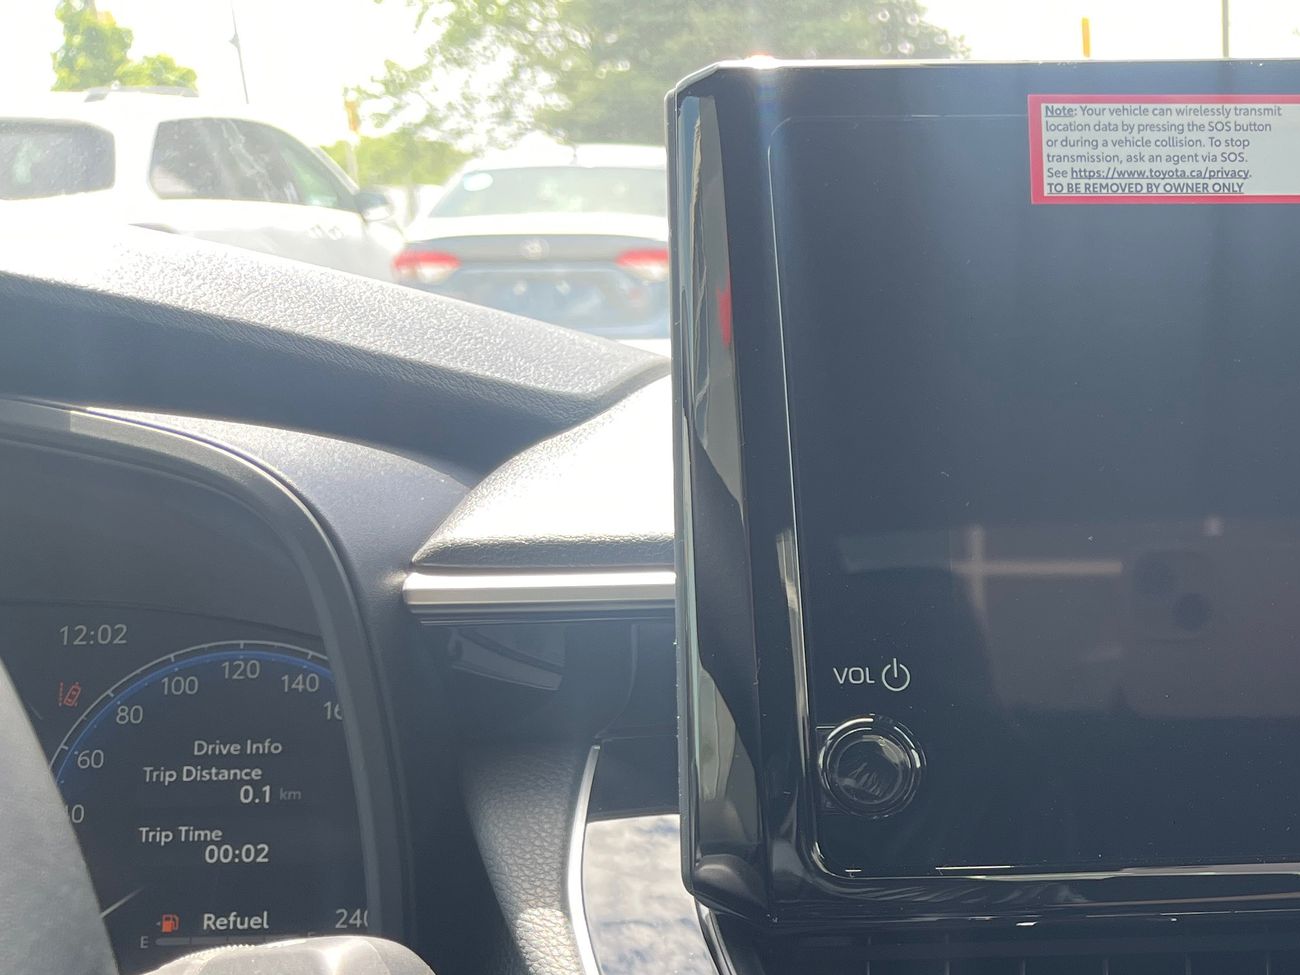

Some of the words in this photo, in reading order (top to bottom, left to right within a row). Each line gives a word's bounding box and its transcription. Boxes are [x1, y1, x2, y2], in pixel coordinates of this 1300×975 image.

[1045, 105, 1078, 117] Note:
[1079, 105, 1107, 116] Your
[1108, 105, 1150, 116] vehicle
[1151, 108, 1173, 116] can
[1175, 105, 1232, 118] wirelessly
[1234, 105, 1282, 116] transmit
[1046, 121, 1091, 132] location
[1093, 121, 1119, 132] data
[1121, 121, 1136, 135] by
[1137, 121, 1185, 135] pressing
[1186, 121, 1206, 132] the
[1208, 121, 1232, 132] SOS
[1233, 121, 1272, 132] button
[1046, 139, 1059, 148] or
[1060, 136, 1099, 150] during
[1101, 139, 1109, 148] a
[1111, 136, 1152, 148] vehicle
[1154, 136, 1206, 148] collision.
[1208, 136, 1222, 148] To
[1224, 138, 1251, 150] stop
[1047, 152, 1123, 165] transmission,
[1126, 152, 1146, 163] ask
[1147, 154, 1163, 163] an
[1165, 152, 1199, 165] agent
[1201, 152, 1218, 163] via
[1220, 152, 1249, 163] SOS.
[1047, 166, 1069, 178] See
[1047, 182, 1064, 194] TO
[1066, 182, 1081, 194] BE
[1084, 182, 1144, 194] REMOVED
[1146, 182, 1161, 194] BY
[1163, 182, 1209, 194] OWNER
[1211, 182, 1245, 194] ONLY
[59, 623, 128, 646] 12:02
[221, 660, 261, 680] 120
[833, 667, 876, 684] VOL
[160, 676, 199, 696] 100
[281, 673, 320, 694] 140
[115, 705, 144, 725] 80
[193, 740, 241, 756] Drive
[246, 739, 283, 755] Info
[77, 750, 105, 769] 60
[144, 767, 177, 783] Trip
[183, 766, 262, 782] Distance
[240, 785, 272, 804] 0.1
[279, 787, 302, 800] km
[139, 827, 173, 845] Trip
[178, 826, 223, 842] Time
[204, 845, 270, 864] 00:02
[203, 912, 270, 931] Refuel
[140, 936, 149, 948] E
